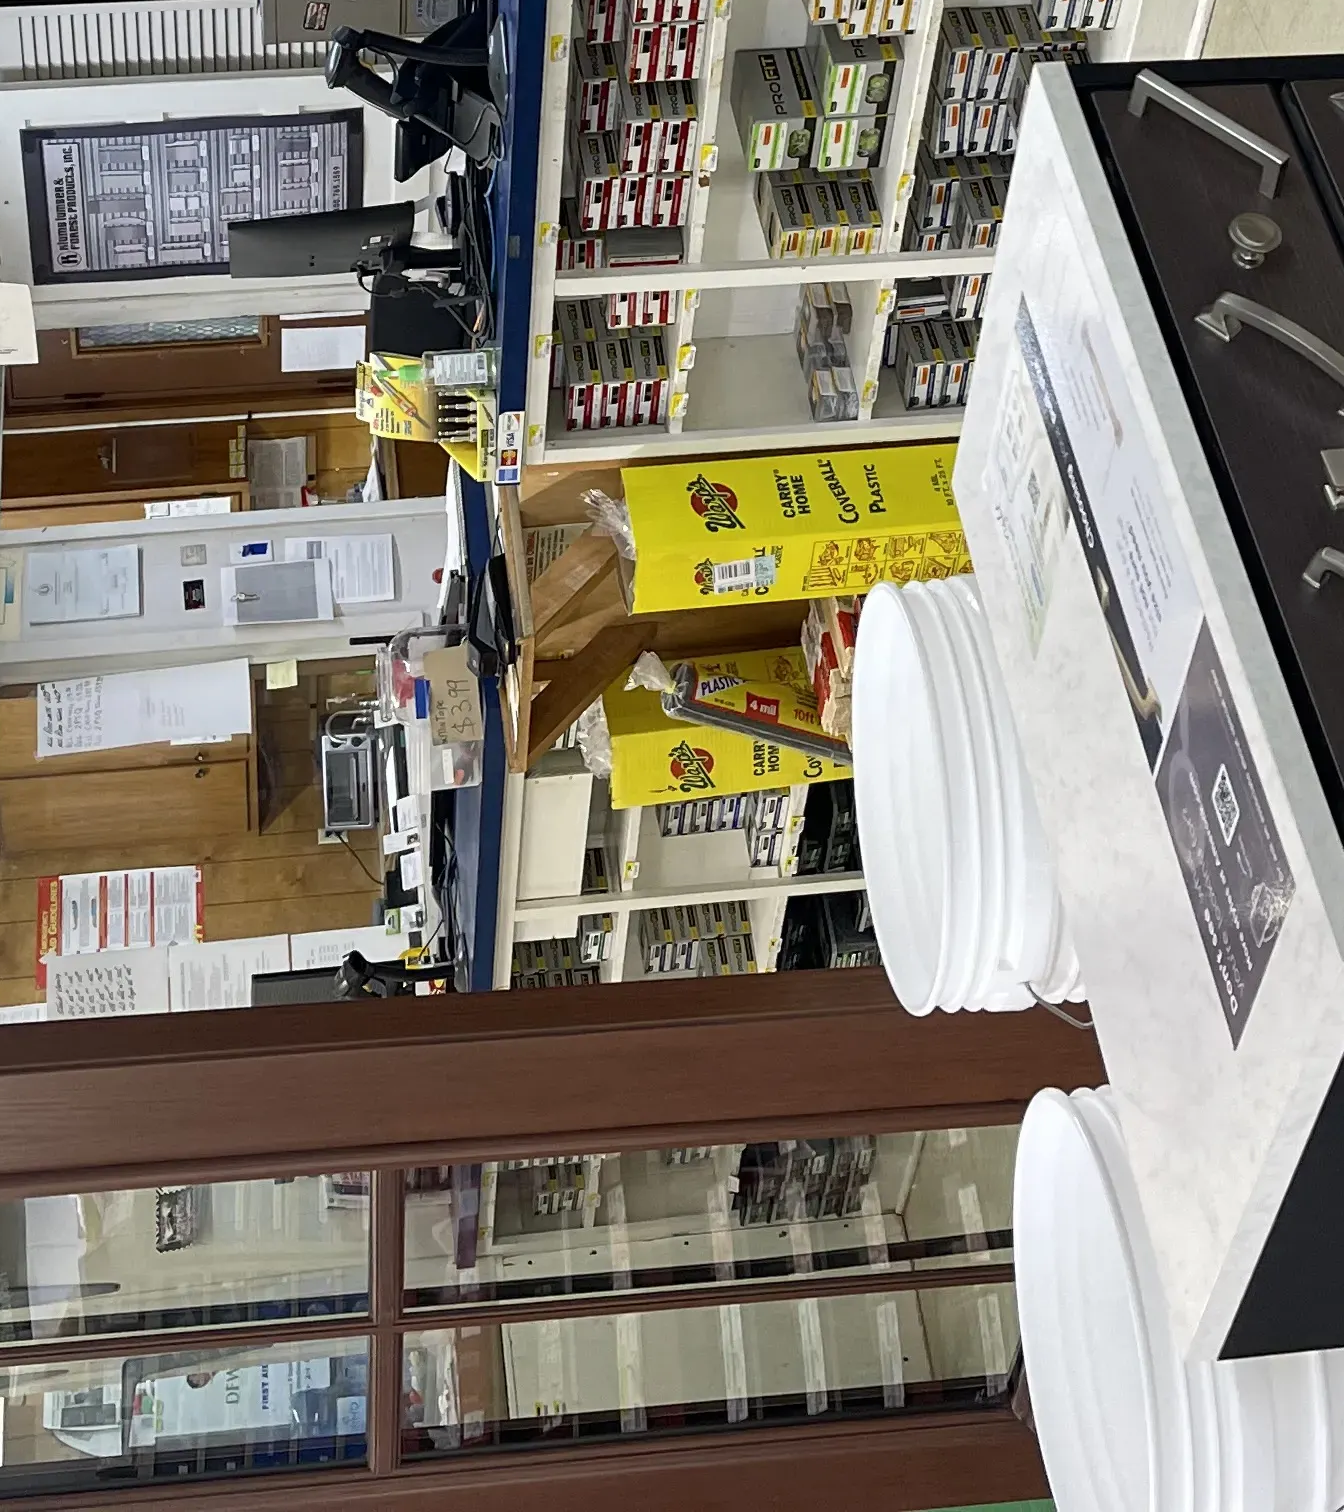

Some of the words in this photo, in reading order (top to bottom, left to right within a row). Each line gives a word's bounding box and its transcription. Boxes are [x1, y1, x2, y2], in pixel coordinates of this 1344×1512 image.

[686, 474, 746, 532] Warp's
[790, 474, 811, 514] HOME
[864, 464, 886, 513] PLASTIC
[752, 740, 765, 776] CARR
[768, 745, 780, 772] HOM
[1216, 949, 1238, 1015] Don't
